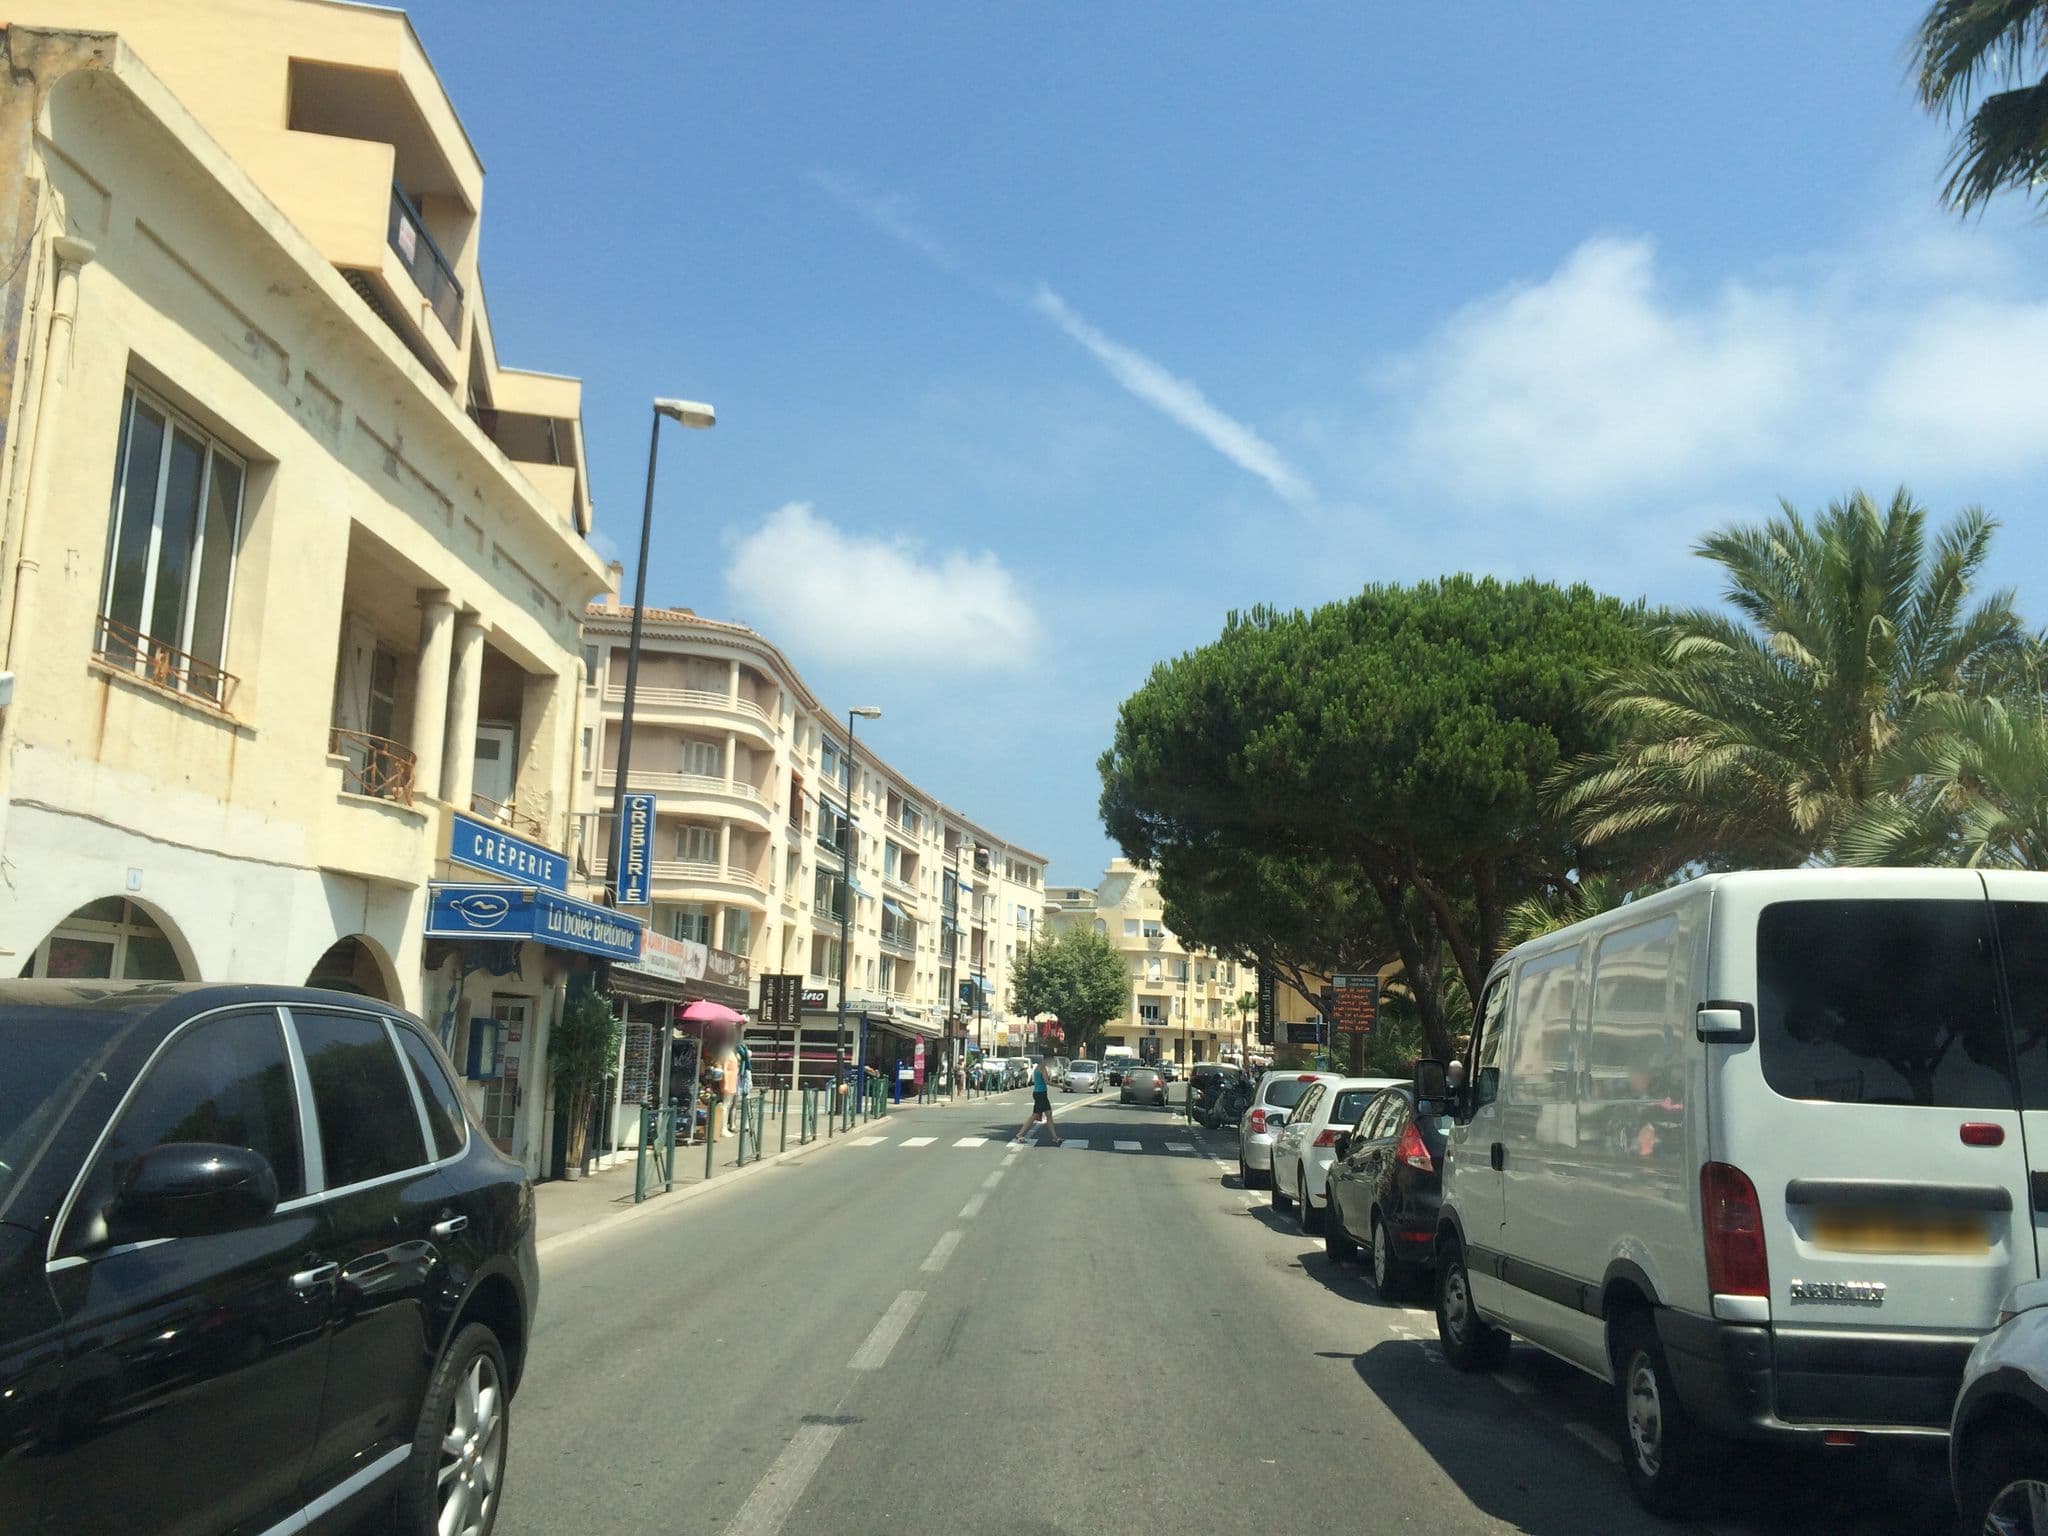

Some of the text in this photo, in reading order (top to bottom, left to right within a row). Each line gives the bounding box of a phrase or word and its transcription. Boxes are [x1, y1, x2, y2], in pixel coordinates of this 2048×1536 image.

[474, 834, 552, 880] CRÊPERIE
[548, 902, 562, 931] La
[593, 915, 634, 950] Bretonne
